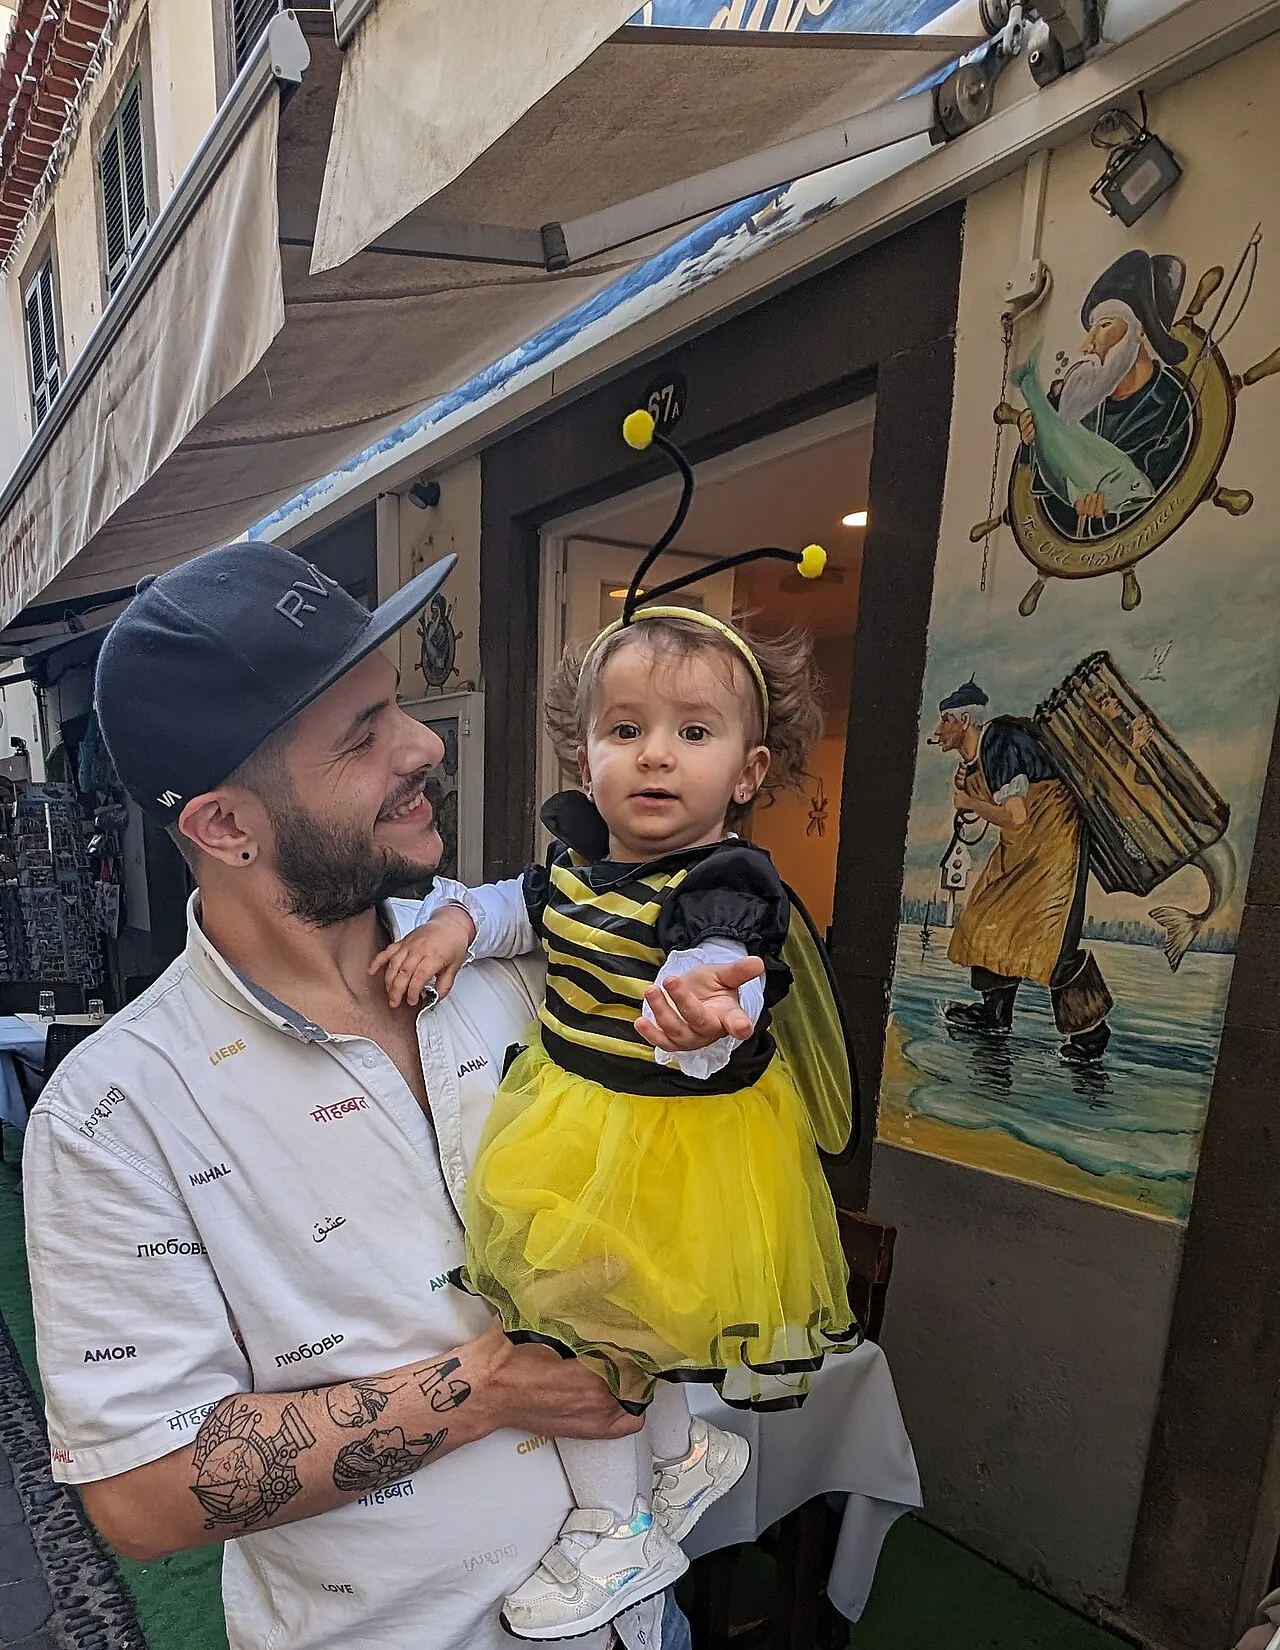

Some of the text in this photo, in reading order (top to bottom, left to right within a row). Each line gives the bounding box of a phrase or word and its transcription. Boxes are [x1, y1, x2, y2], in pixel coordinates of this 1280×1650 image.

[209, 1038, 247, 1067] LIEBE
[309, 1096, 370, 1123] मोहब्बत
[188, 1162, 232, 1187] MAHAL
[312, 1216, 346, 1243] عشق
[137, 1238, 208, 1258] любовь
[429, 1270, 452, 1292] AM
[83, 1345, 138, 1363] AMOR
[274, 1333, 344, 1368] любовь
[320, 1583, 354, 1594] LOVE
